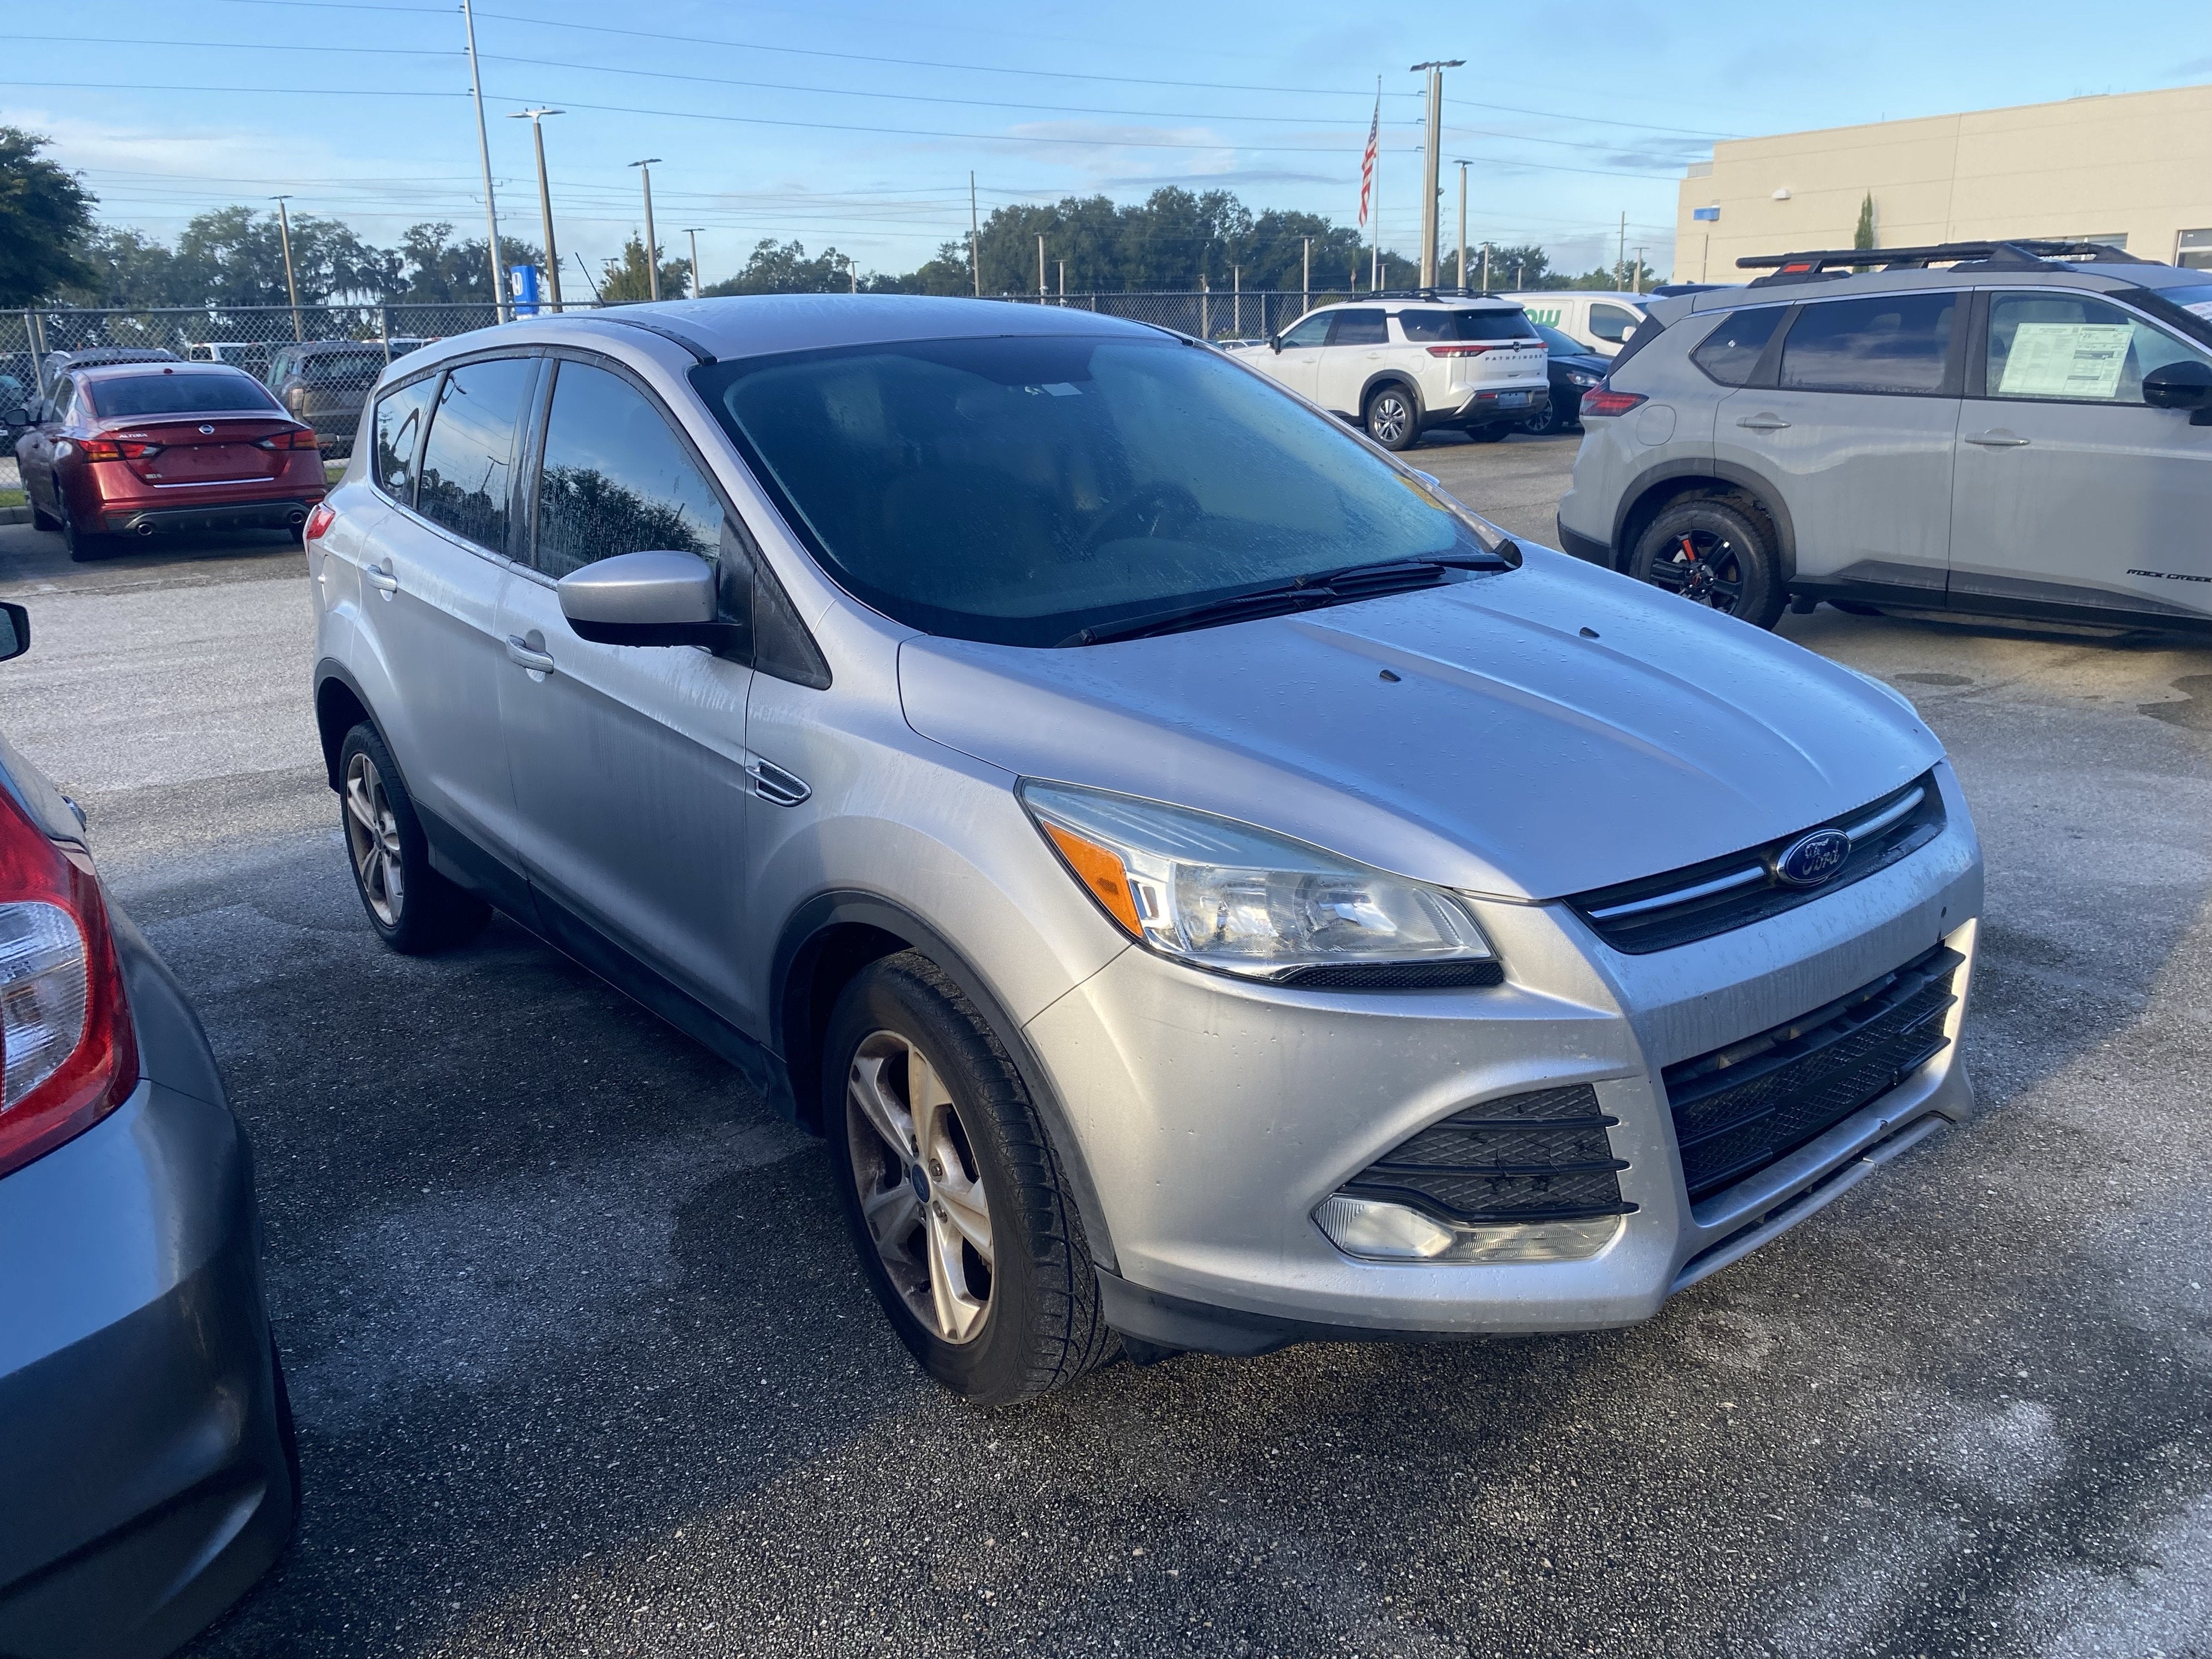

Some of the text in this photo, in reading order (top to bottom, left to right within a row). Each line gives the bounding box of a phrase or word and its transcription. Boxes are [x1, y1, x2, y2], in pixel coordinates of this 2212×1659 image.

[2126, 569, 2212, 583] ROCK CREEK
[1803, 838, 1839, 876] Ford
